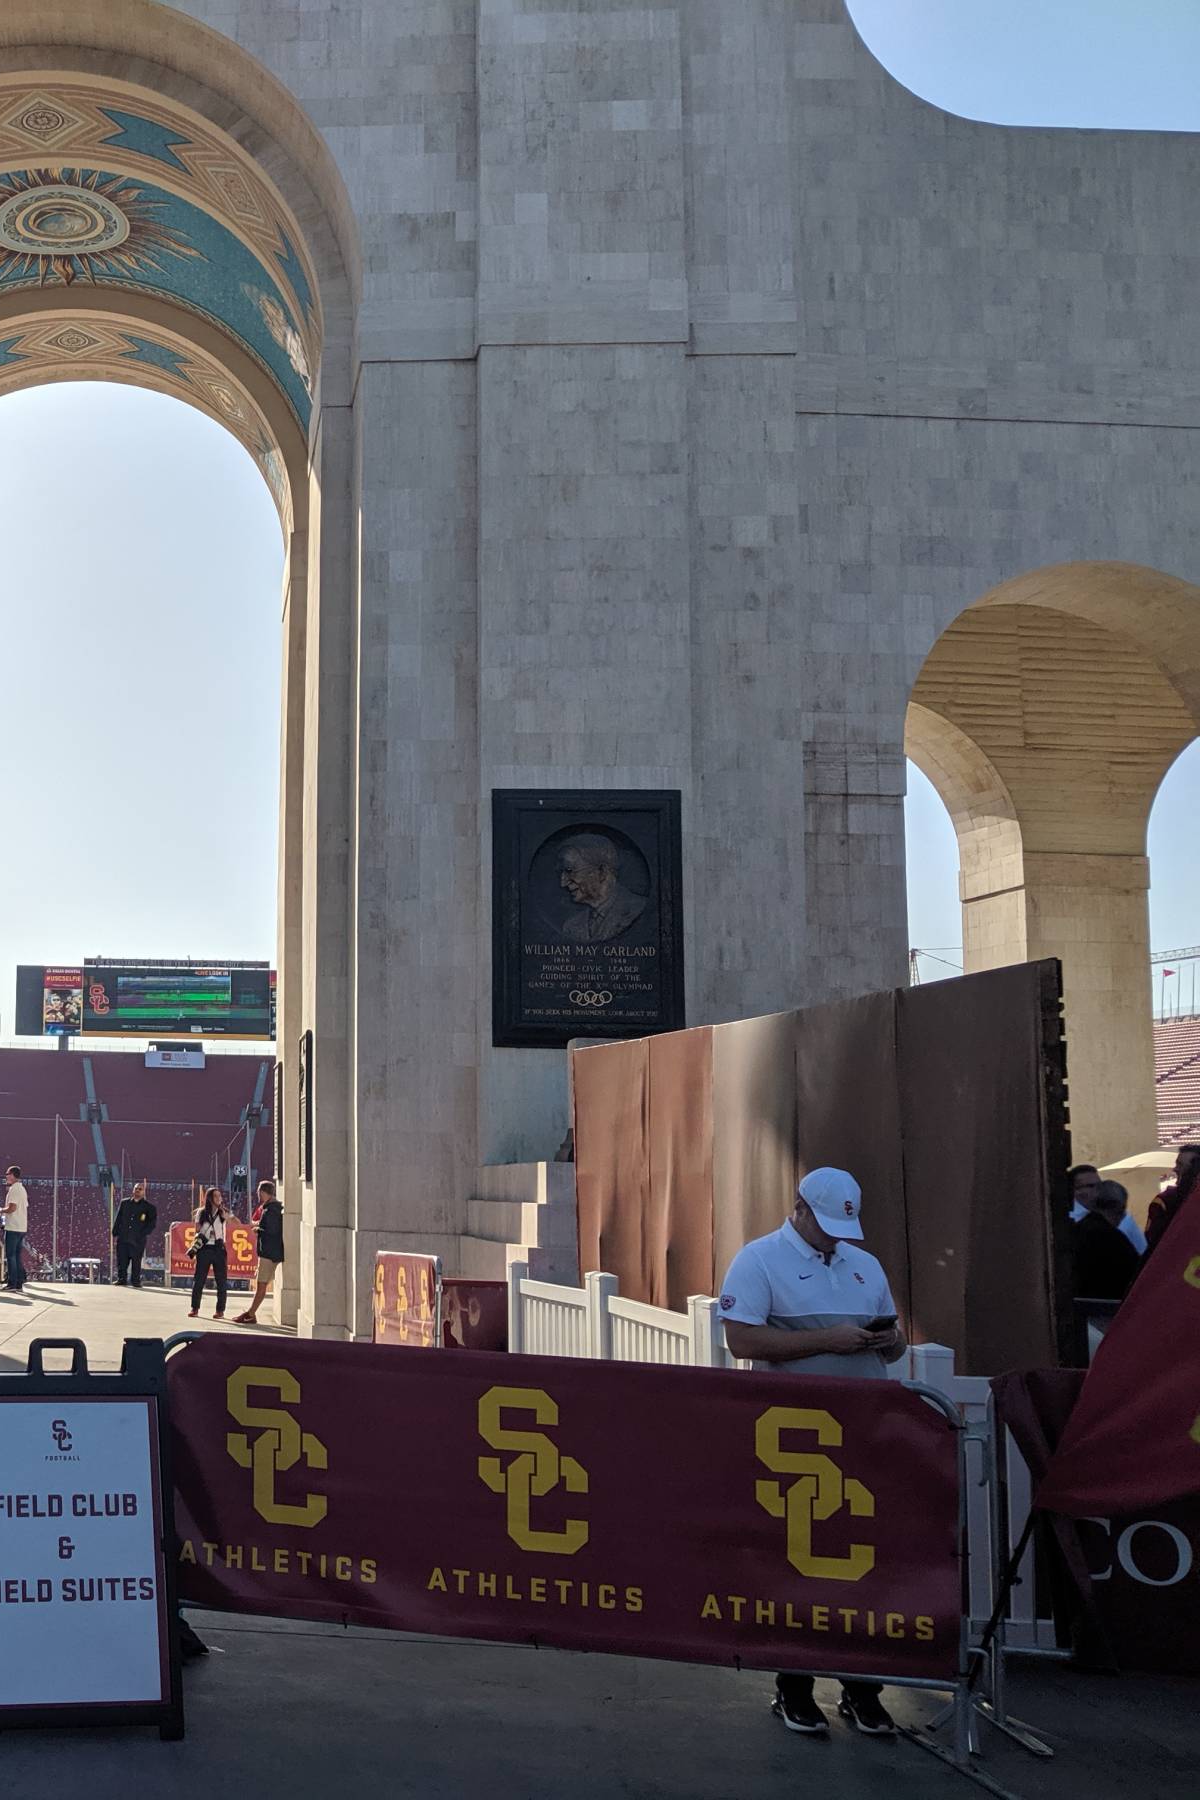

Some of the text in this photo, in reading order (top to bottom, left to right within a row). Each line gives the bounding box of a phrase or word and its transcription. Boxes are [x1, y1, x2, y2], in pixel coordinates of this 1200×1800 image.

[524, 944, 656, 957] WILLIAM MAY GARLAND
[625, 974, 641, 982] THE
[89, 984, 110, 1015] SC
[533, 1008, 544, 1016] YOU
[626, 1010, 645, 1018] ABOUT
[234, 1165, 248, 1176] 25
[844, 1200, 854, 1216] SC
[232, 1229, 252, 1262] SC
[52, 1419, 73, 1451] SC
[227, 1366, 328, 1528] SC
[478, 1385, 589, 1555] SC
[72, 1493, 138, 1517] CLUB
[755, 1406, 875, 1581] SC
[58, 1536, 76, 1560] &
[179, 1540, 378, 1584] ATHLETICS
[62, 1577, 154, 1602] SUITES
[427, 1567, 644, 1613] ATHLETICS
[701, 1593, 936, 1641] ATHLETICS
